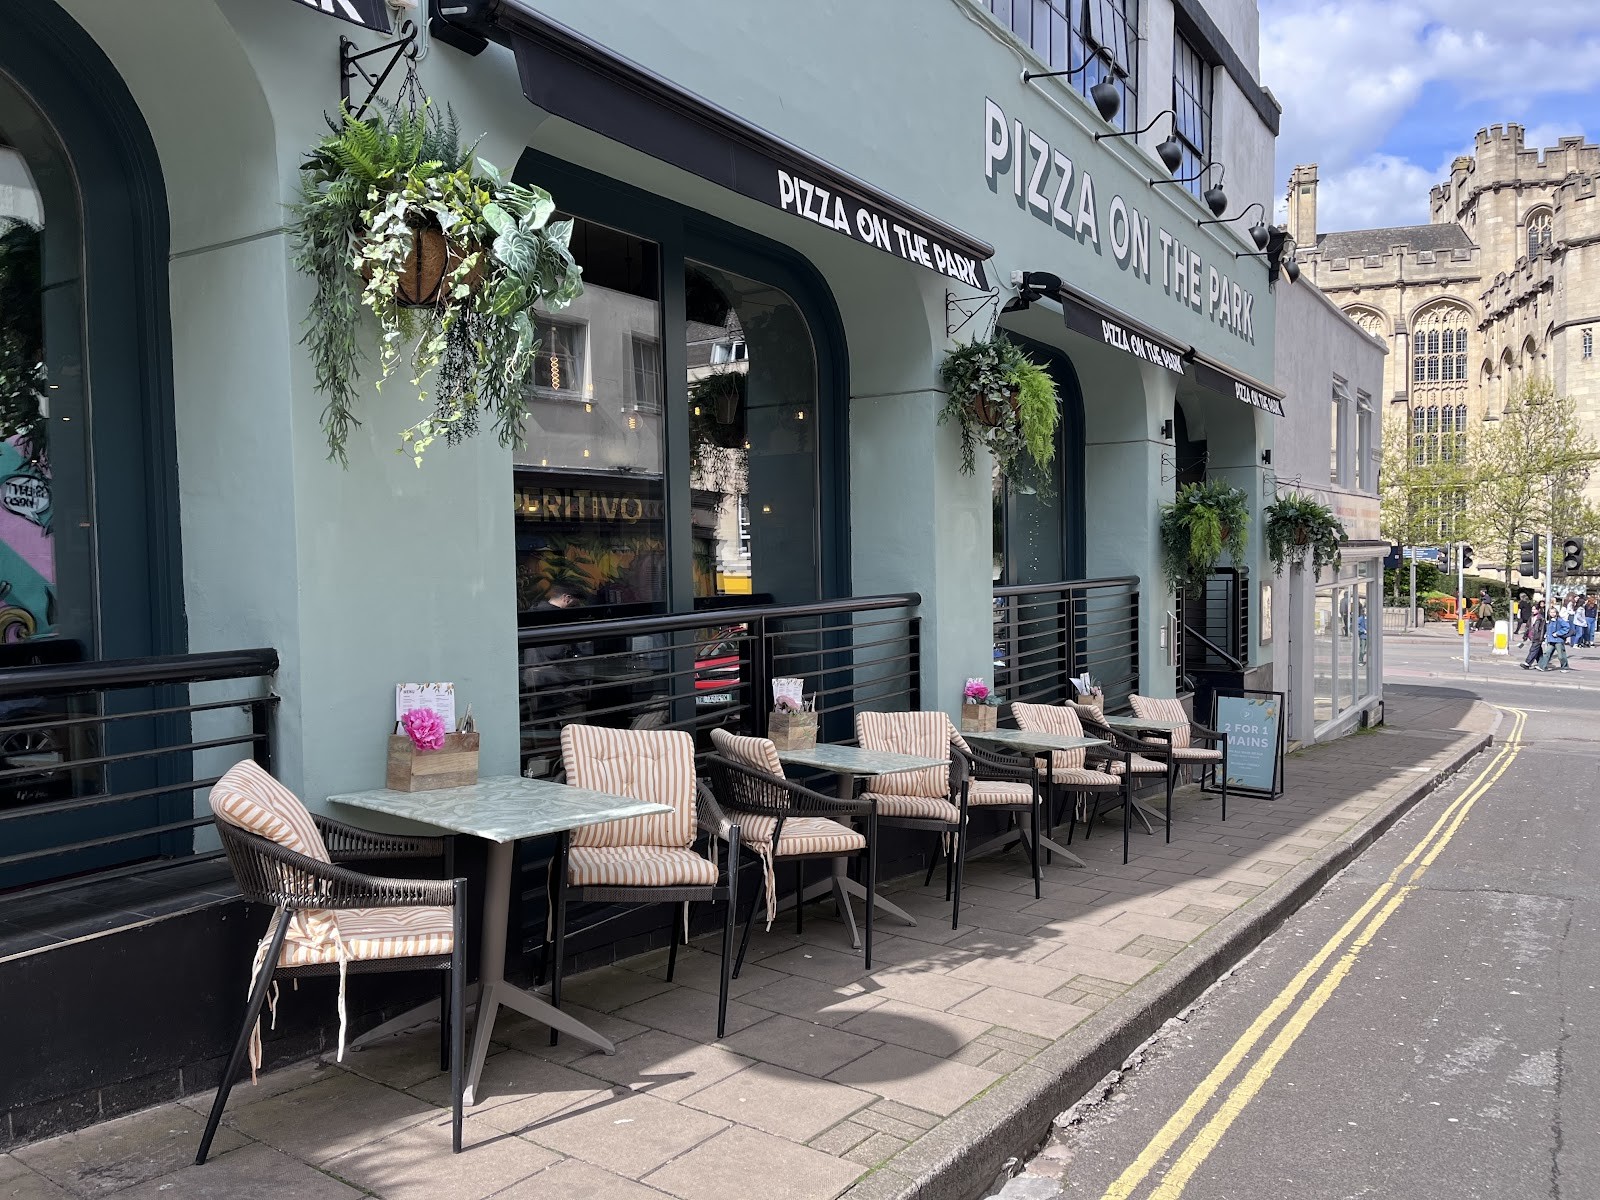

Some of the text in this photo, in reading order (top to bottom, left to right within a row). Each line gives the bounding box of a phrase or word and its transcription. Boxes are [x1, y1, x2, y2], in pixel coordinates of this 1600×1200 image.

[778, 169, 981, 288] PIZZA ON THE PARK
[985, 97, 1254, 345] PIZZA ON THE PARK
[1101, 319, 1184, 375] PIZZA ON THE PARK
[1225, 723, 1268, 735] 2 FOR 1
[1228, 735, 1269, 748] MAINS
